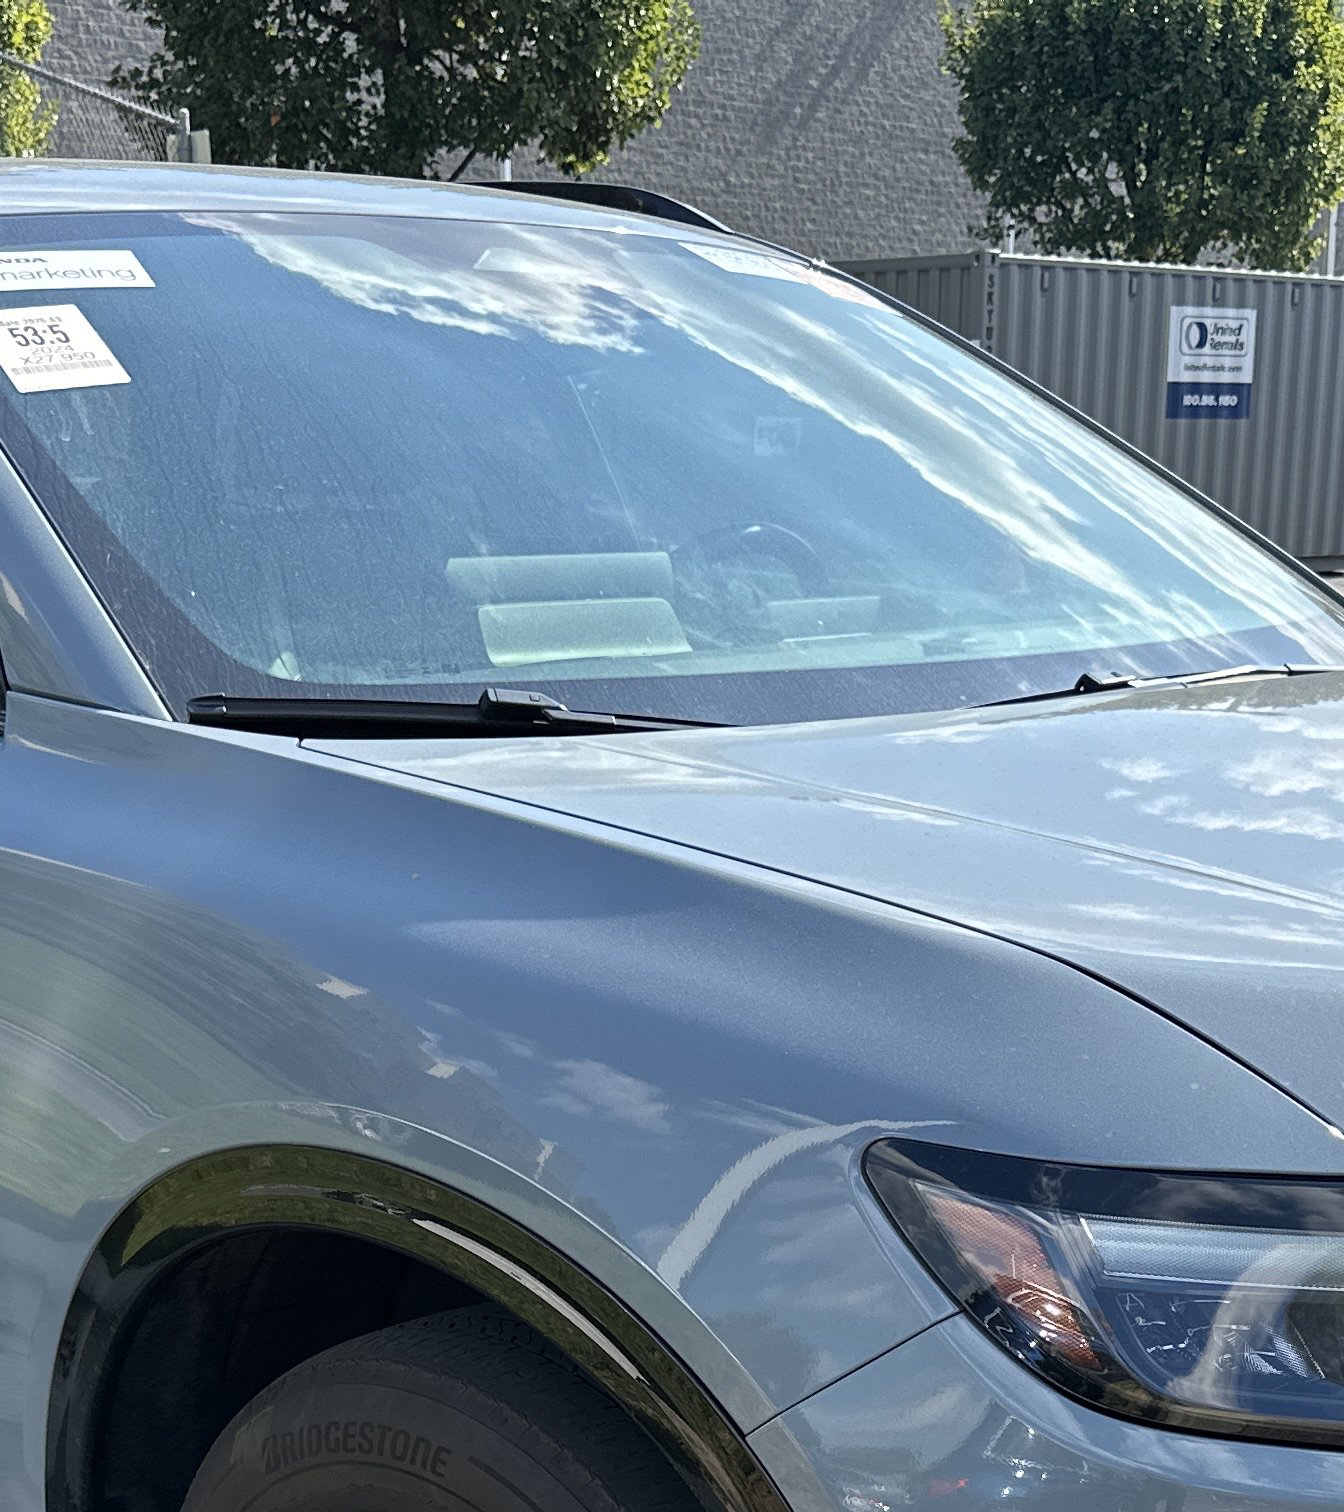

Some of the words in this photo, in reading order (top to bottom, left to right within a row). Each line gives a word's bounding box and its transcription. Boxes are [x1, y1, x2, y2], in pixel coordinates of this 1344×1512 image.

[7, 324, 70, 347] 53:5
[1210, 323, 1244, 336] Unied
[30, 344, 75, 355] 2024
[261, 1421, 452, 1478] BRIDGESTONE
